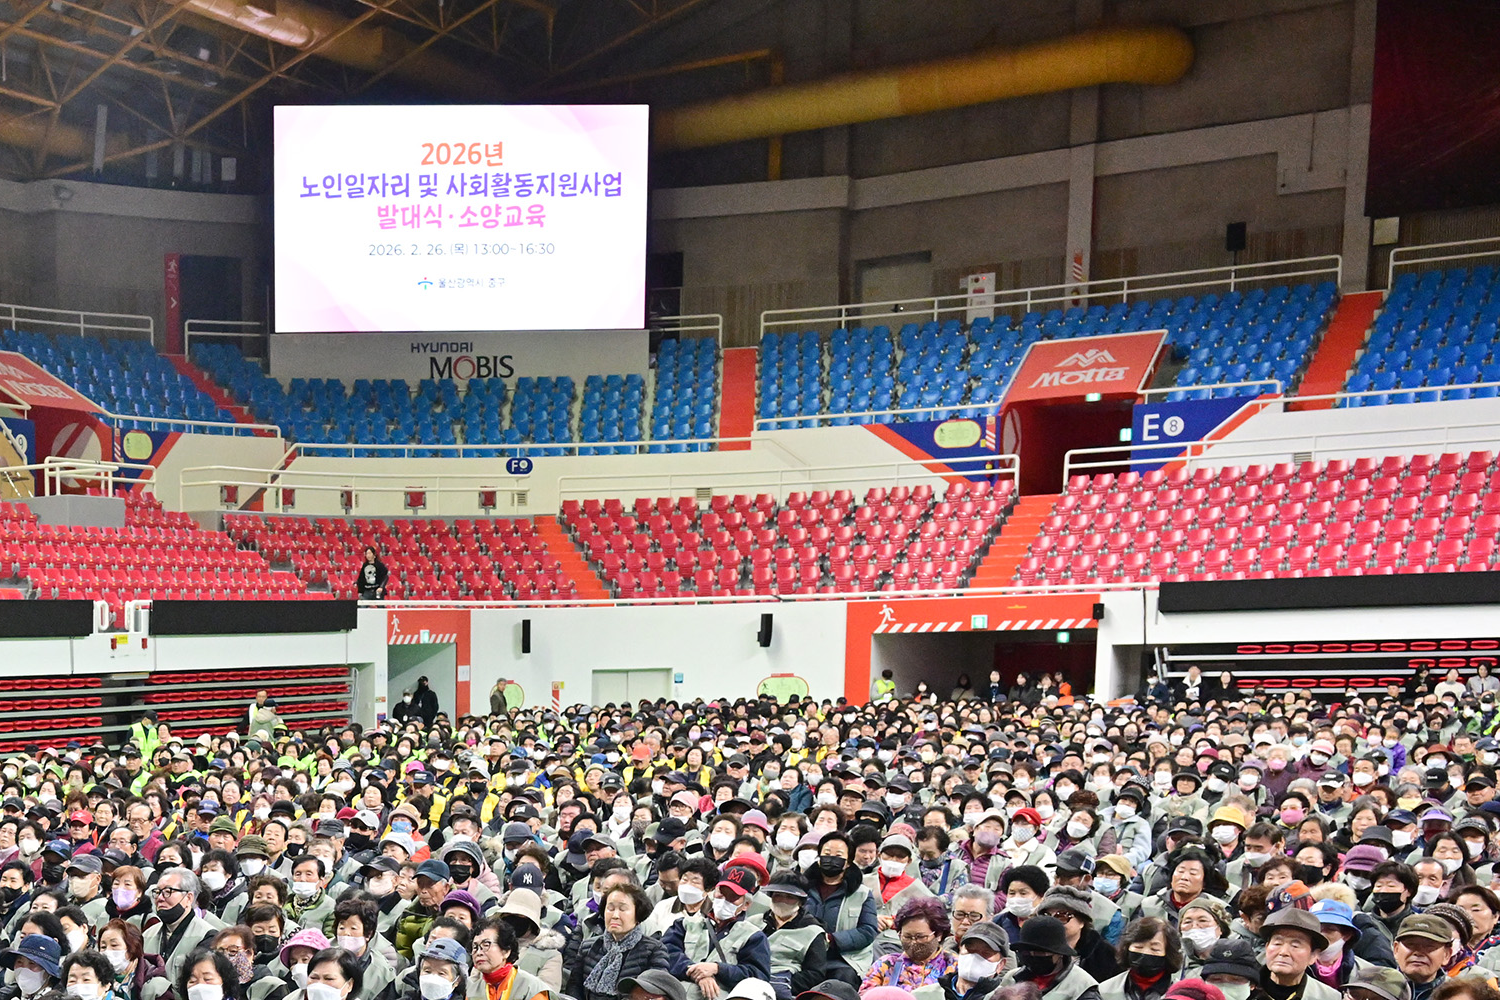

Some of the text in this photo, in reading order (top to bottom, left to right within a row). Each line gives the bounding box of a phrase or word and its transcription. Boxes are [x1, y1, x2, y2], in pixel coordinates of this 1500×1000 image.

[420, 141, 504, 167] 2026년
[299, 171, 622, 199] 노인일자리 및 사회활동지원사업
[368, 244, 405, 256] 2026.
[411, 244, 422, 256] 2.
[427, 244, 447, 256] 26.
[410, 342, 474, 353] HYUNDAI
[429, 355, 515, 380] MOBIS
[1142, 413, 1160, 441] E
